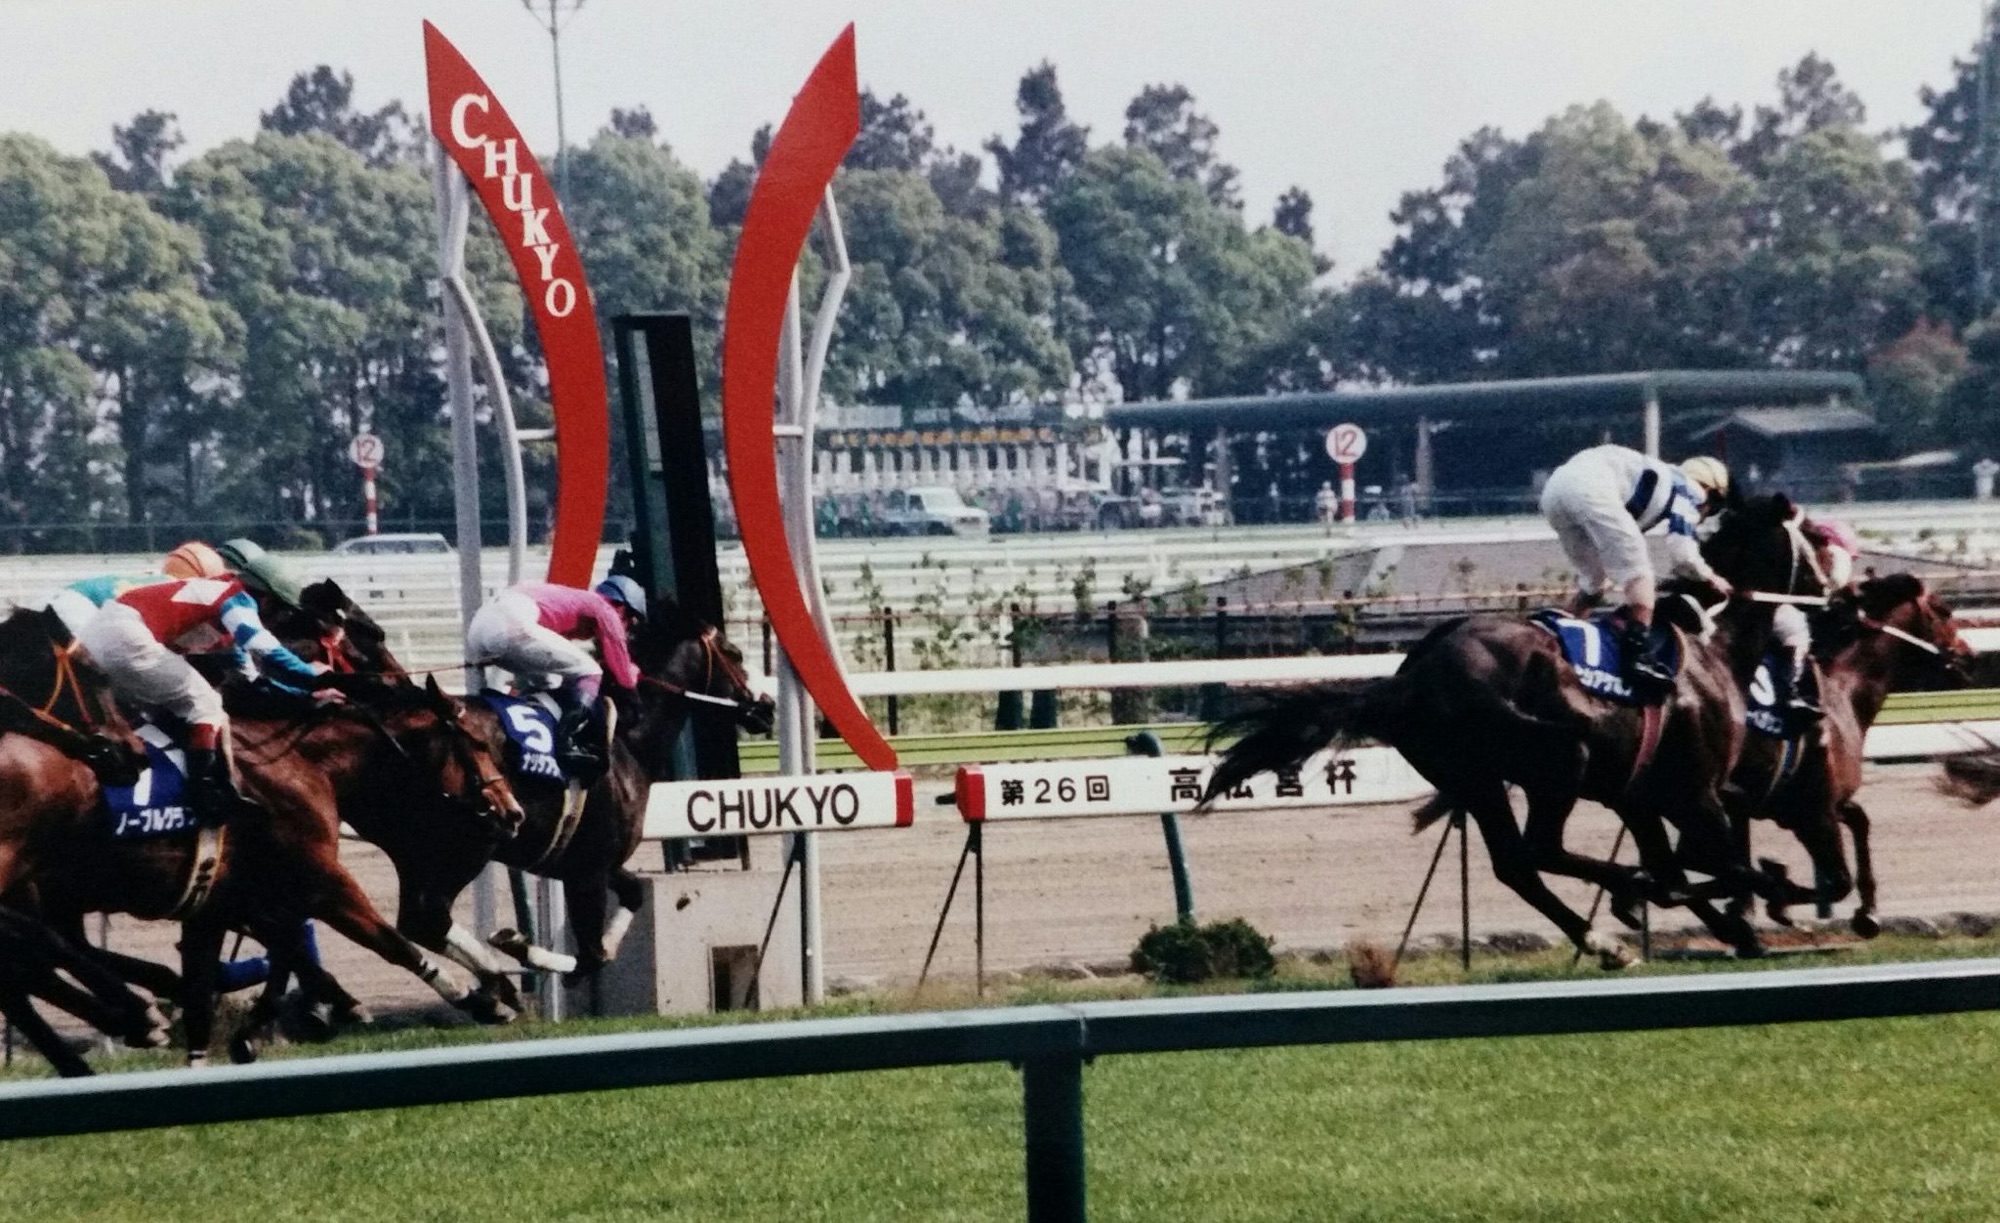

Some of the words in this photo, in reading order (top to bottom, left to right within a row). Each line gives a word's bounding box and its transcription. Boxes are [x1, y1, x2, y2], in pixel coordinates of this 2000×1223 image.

[450, 93, 577, 318] CHUKYO
[355, 438, 377, 462] 12
[1334, 429, 1358, 457] 12
[506, 704, 553, 753] 5
[687, 783, 859, 832] CHUKYO
[1000, 775, 1110, 806] 第26回
